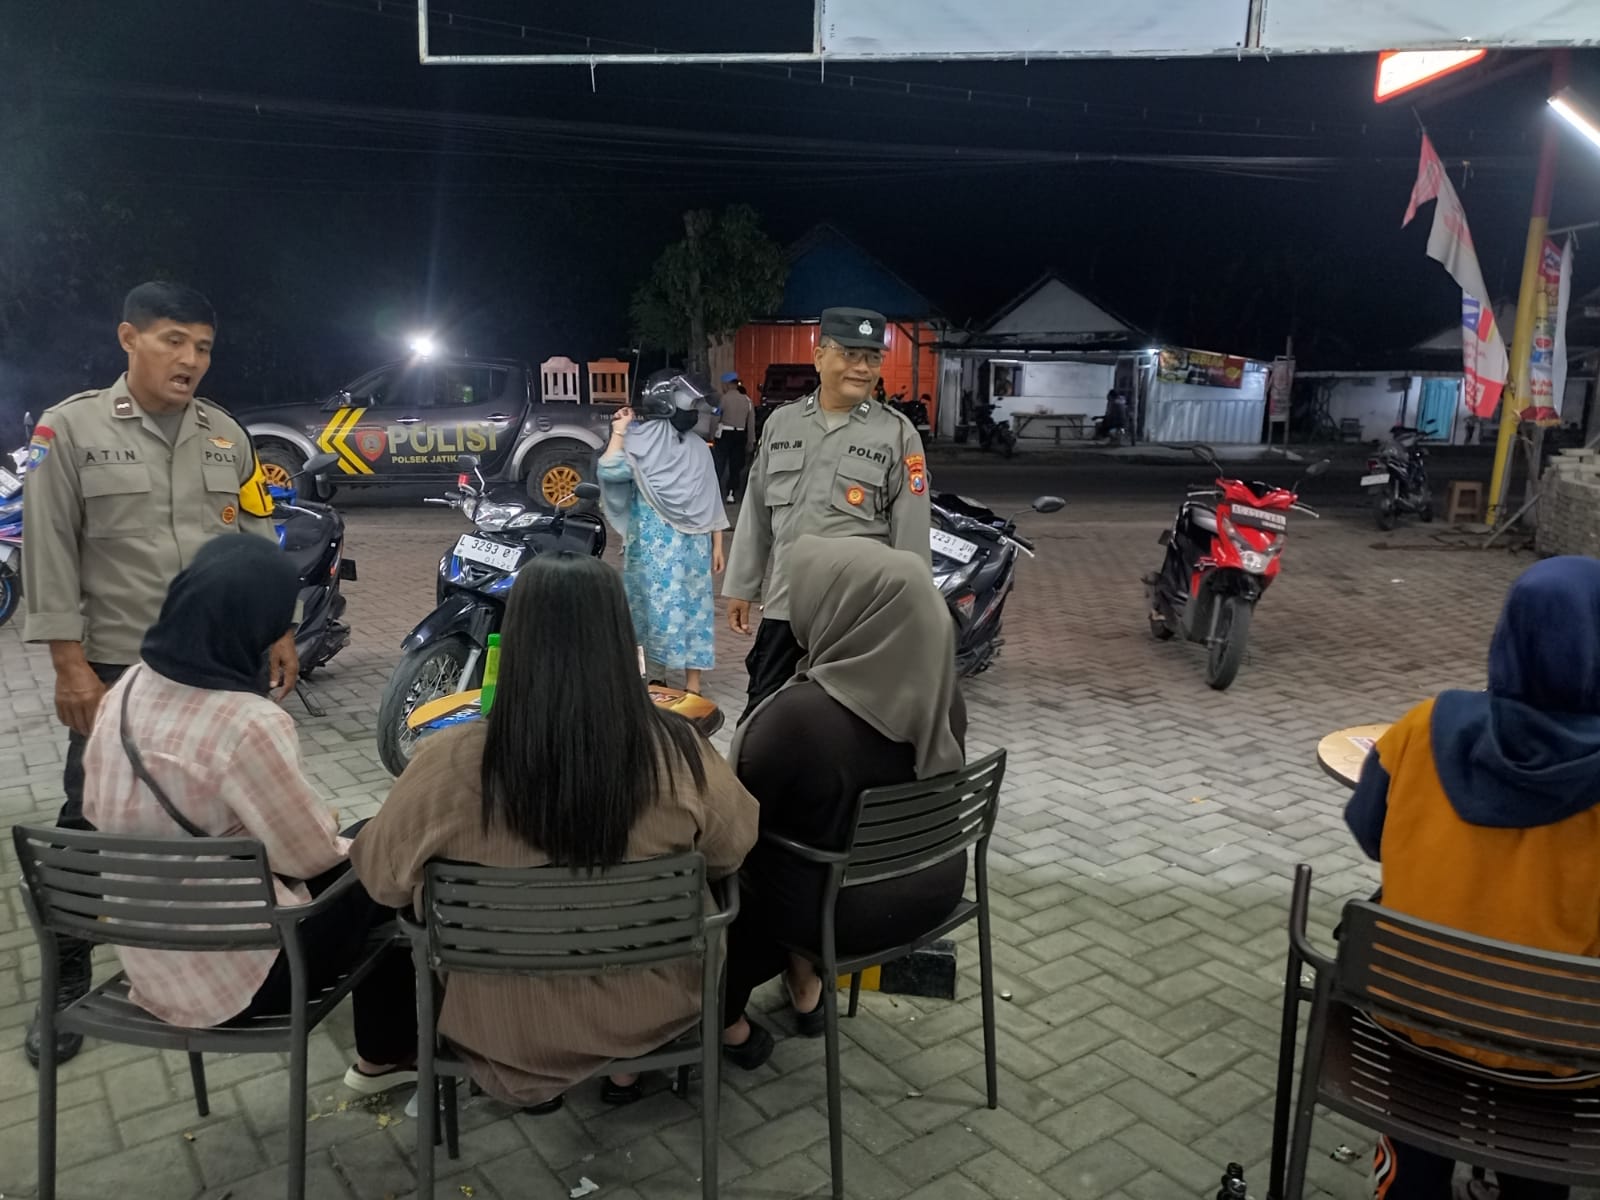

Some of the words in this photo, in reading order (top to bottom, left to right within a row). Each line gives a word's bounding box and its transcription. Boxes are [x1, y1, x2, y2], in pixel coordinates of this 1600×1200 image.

[388, 423, 497, 454] POLISI
[86, 450, 136, 463] ATIN
[392, 455, 428, 463] POLSEK
[848, 445, 886, 464] POLRI
[460, 536, 466, 546] L
[472, 539, 499, 555] 3293
